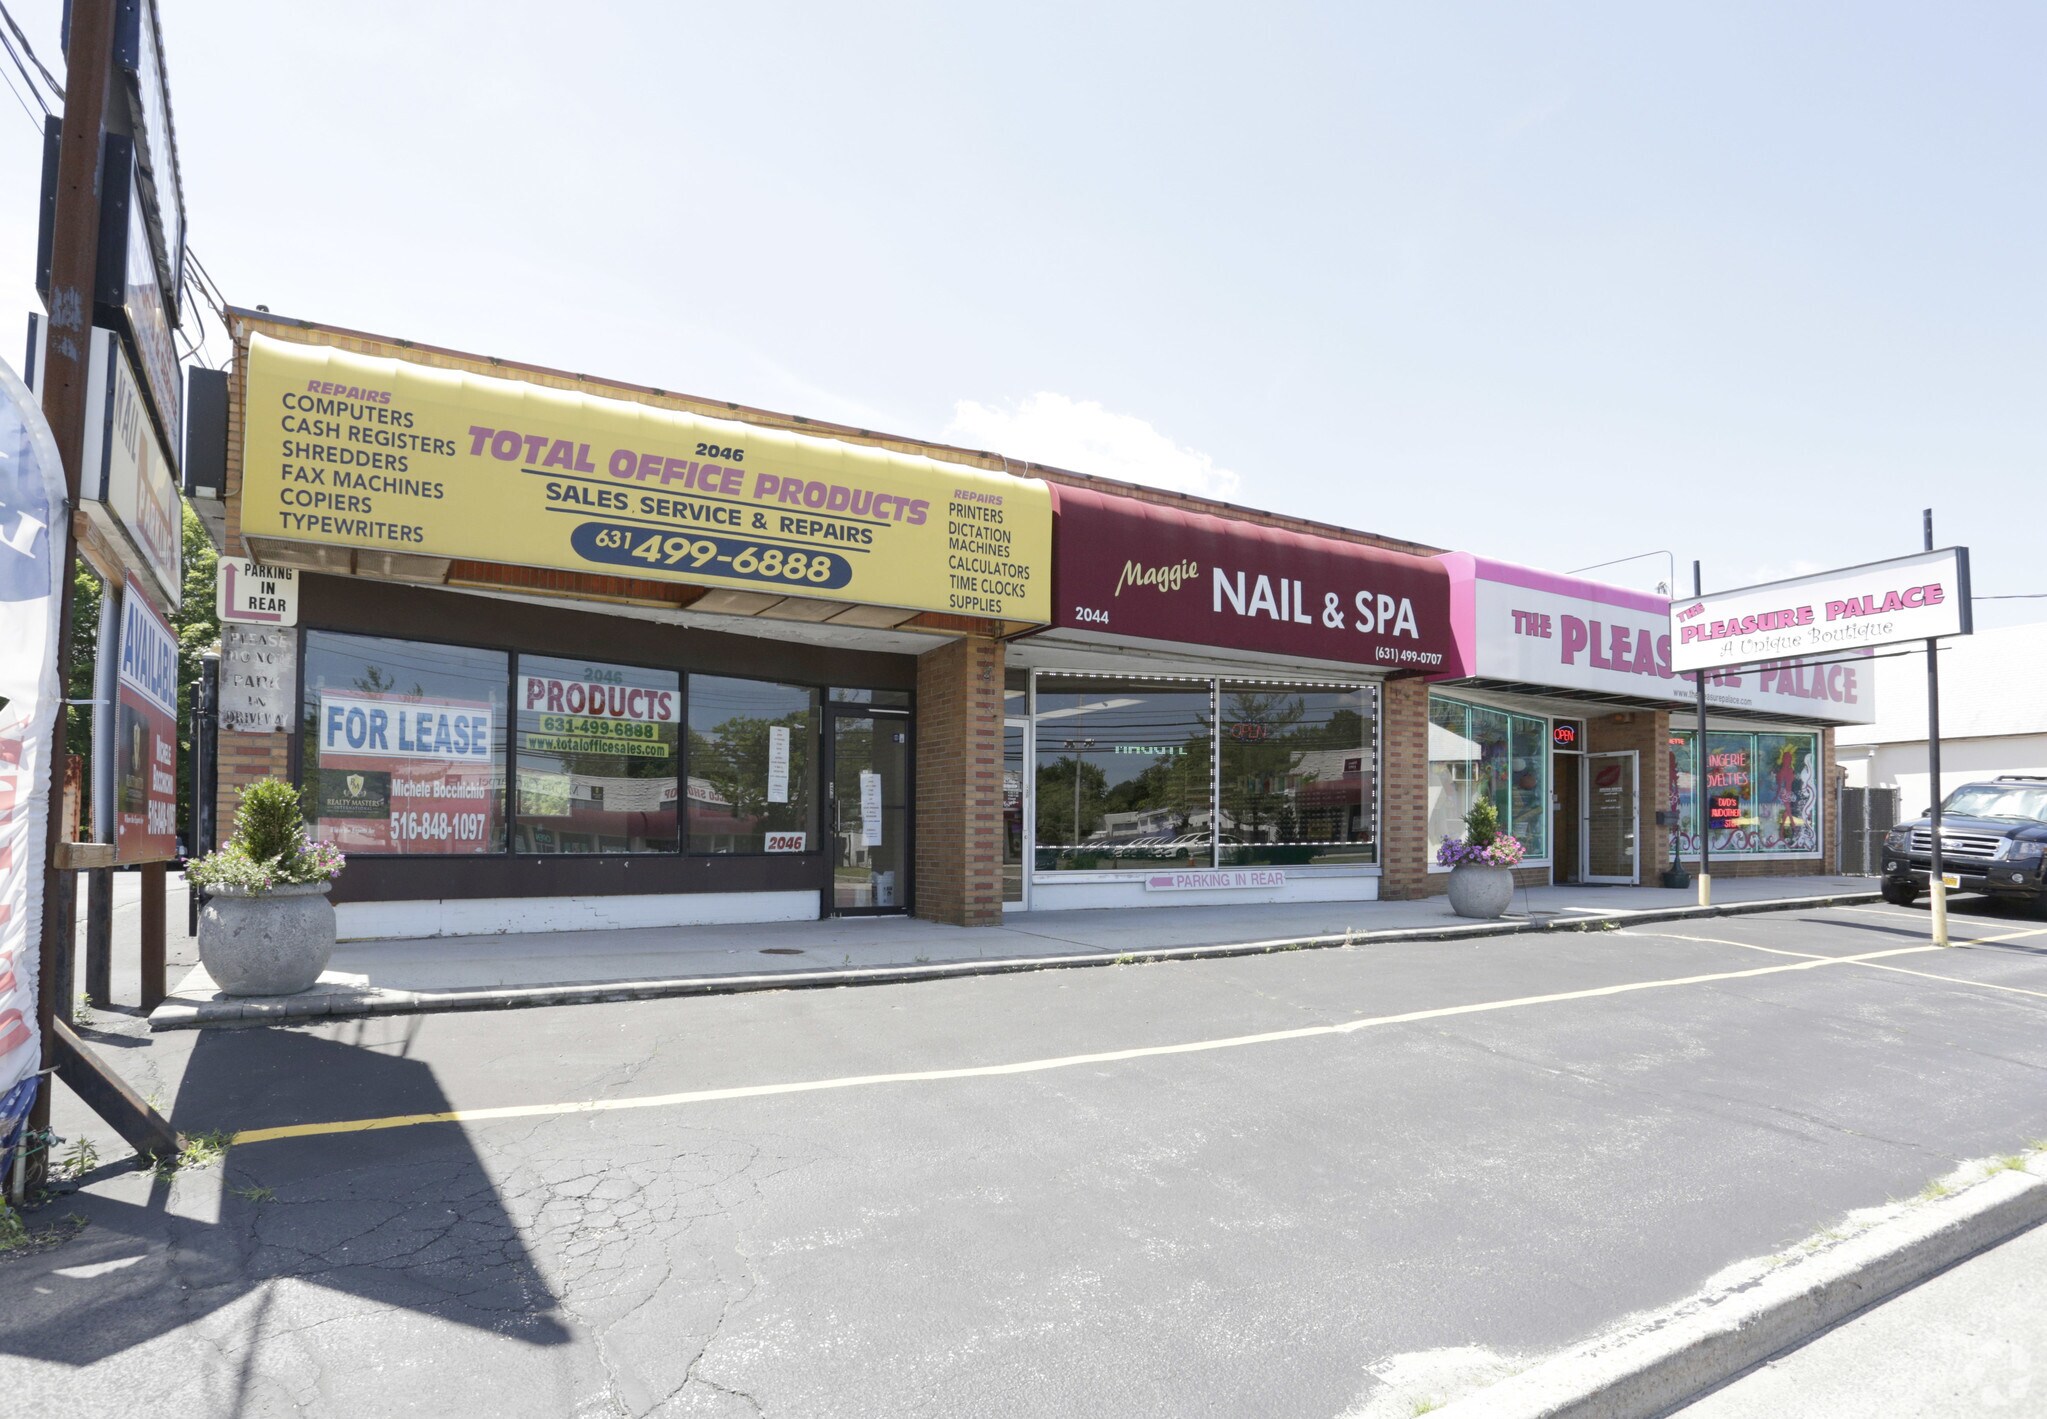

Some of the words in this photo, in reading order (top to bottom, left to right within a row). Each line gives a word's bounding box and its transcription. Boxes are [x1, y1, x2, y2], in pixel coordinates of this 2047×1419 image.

[307, 379, 391, 404] REPAIRS
[115, 368, 139, 464] NAIL
[282, 393, 414, 428] COMPUTERS
[282, 415, 340, 440] CASH
[348, 422, 456, 457] REGISTERS
[282, 440, 408, 472] SHREDDERS
[695, 443, 744, 462] 2046
[282, 464, 326, 485] FAX
[333, 471, 444, 499] MACHINES
[468, 425, 595, 474] TOTAL
[608, 449, 745, 496] OFFICE
[753, 472, 930, 526] PRODUCTS
[280, 489, 372, 514] COPIERS
[954, 489, 1003, 506] REPAIRS
[640, 496, 741, 527] SERVICE
[751, 512, 768, 530] &
[779, 516, 873, 545] REPAIRS
[949, 502, 1003, 524] PRINTERS
[279, 511, 424, 543] TYPEWRITERS
[948, 521, 1011, 544] DICTATION
[595, 529, 631, 549] 631
[631, 535, 831, 583] 499-6888
[949, 537, 1010, 558] MACHINES
[244, 563, 292, 580] PARKING
[948, 555, 1030, 580] CALCULATORS
[1115, 559, 1199, 597] Maggie
[261, 581, 275, 595] IN
[950, 574, 978, 593] TIME
[981, 577, 1025, 598] CLOCKS
[249, 596, 286, 612] REAR
[949, 594, 1002, 614] SUPPLIES
[1213, 567, 1312, 625] NAIL
[1322, 592, 1345, 630] &
[1355, 590, 1419, 639] SPA
[1676, 602, 1705, 623] THE
[1681, 606, 1815, 645] PLEASURE
[1825, 583, 1945, 622] PALACE
[1075, 606, 1109, 625] 2044
[230, 632, 288, 648] PLEASE
[1720, 641, 1734, 658] A
[1741, 635, 1802, 653] Unique
[1807, 621, 1893, 646] Boutique
[123, 601, 177, 712] AVAILABLE
[1375, 646, 1399, 663] (631)
[1400, 649, 1442, 666] 499-0707
[1512, 609, 1552, 639] THE
[1760, 659, 1858, 704] PALACE
[234, 674, 281, 690] PARK
[584, 667, 623, 683] 2046
[527, 678, 672, 720] PRODUCTS
[226, 710, 289, 726] DRIVEWAY
[544, 717, 653, 738] 631-499-6888
[327, 705, 388, 749] FOR
[399, 711, 487, 755] LEASE
[1231, 723, 1267, 738] OPEN
[1554, 728, 1574, 742] OPEN
[529, 737, 665, 757] www.totalofficesales.com
[1707, 752, 1746, 768] INGERIE
[392, 779, 431, 798] Michele
[433, 781, 485, 799] Bocchichio
[327, 798, 351, 806] REALTY
[352, 799, 380, 807] MASTERS
[390, 812, 486, 840] 516-848-1097
[768, 836, 803, 850] 2046
[1177, 871, 1230, 888] PARKING
[1235, 873, 1246, 886] IN
[1251, 871, 1284, 886] REAR
